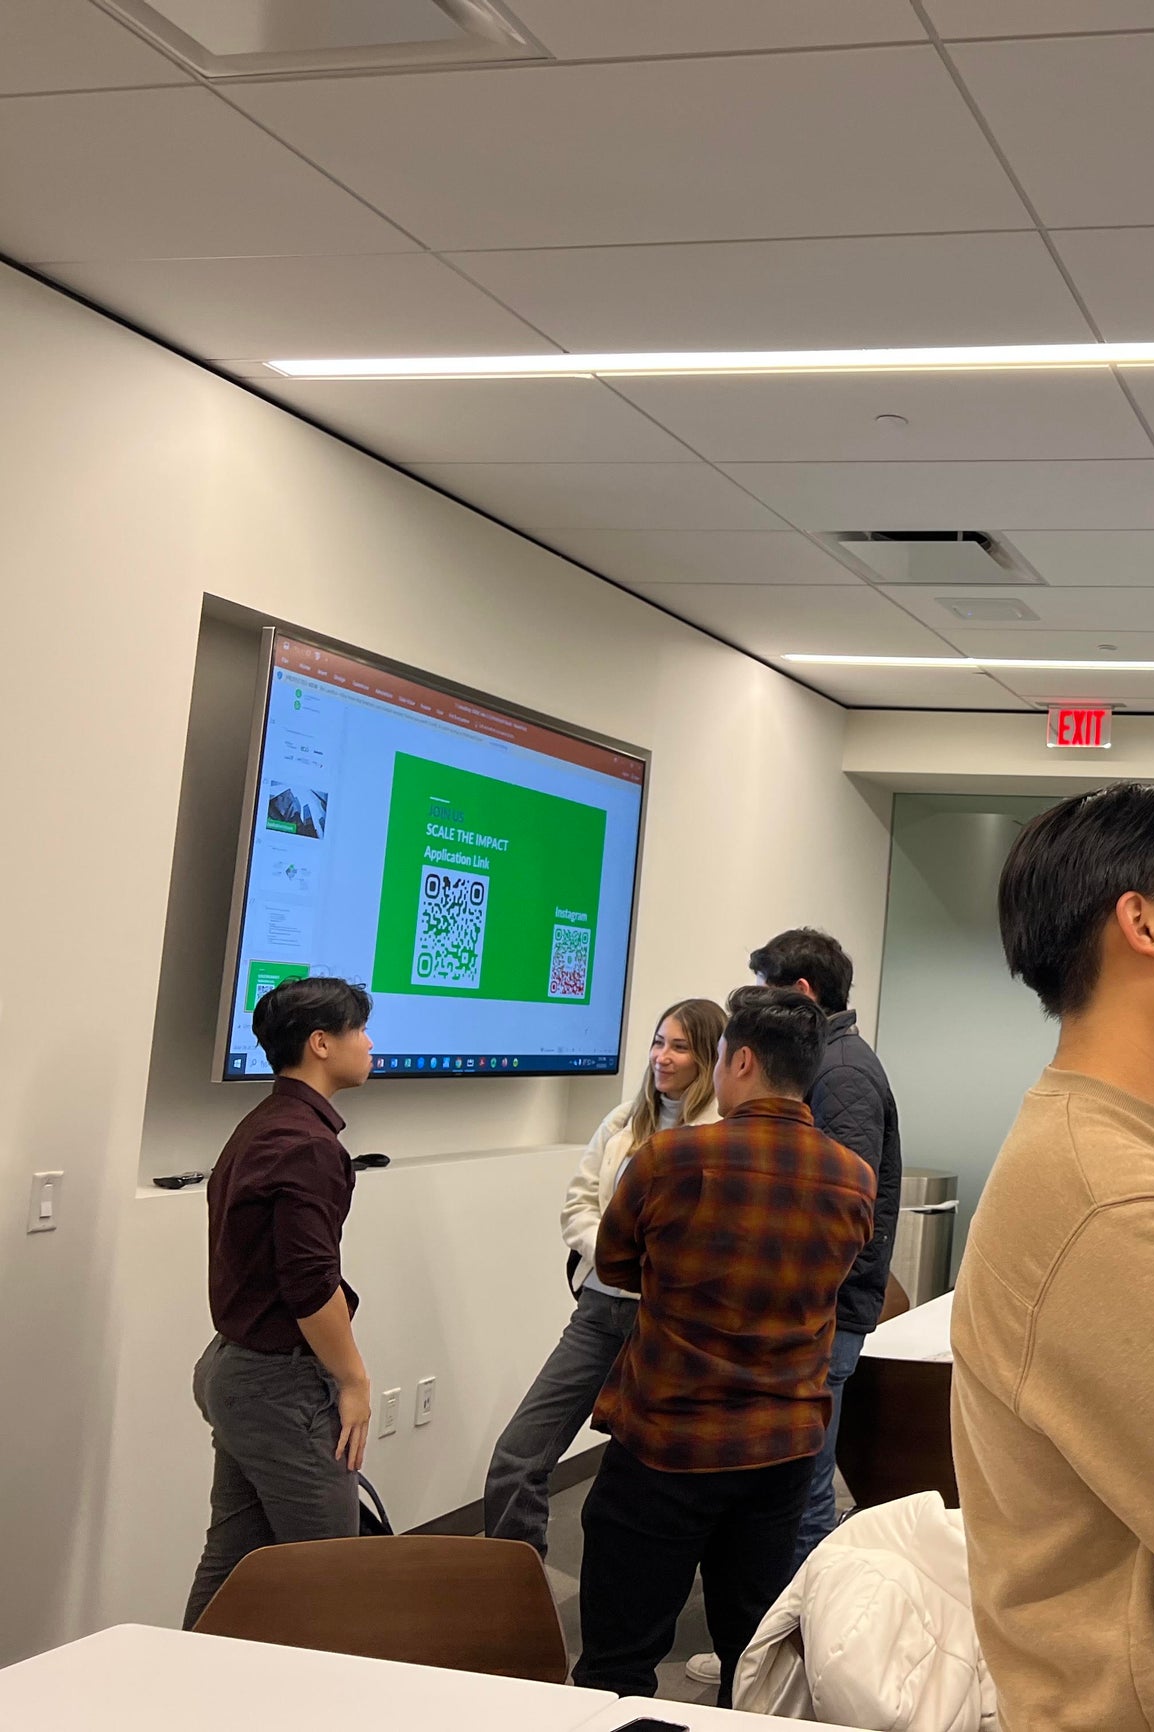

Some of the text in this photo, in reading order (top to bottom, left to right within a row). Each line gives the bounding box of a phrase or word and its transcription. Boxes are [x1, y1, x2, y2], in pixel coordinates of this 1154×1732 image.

[1058, 710, 1105, 745] EXIT
[429, 804, 465, 823] JOIN US
[426, 823, 509, 851] SCALE THE IMPACT
[424, 845, 490, 870] Application Link
[555, 906, 588, 922] Instagram
